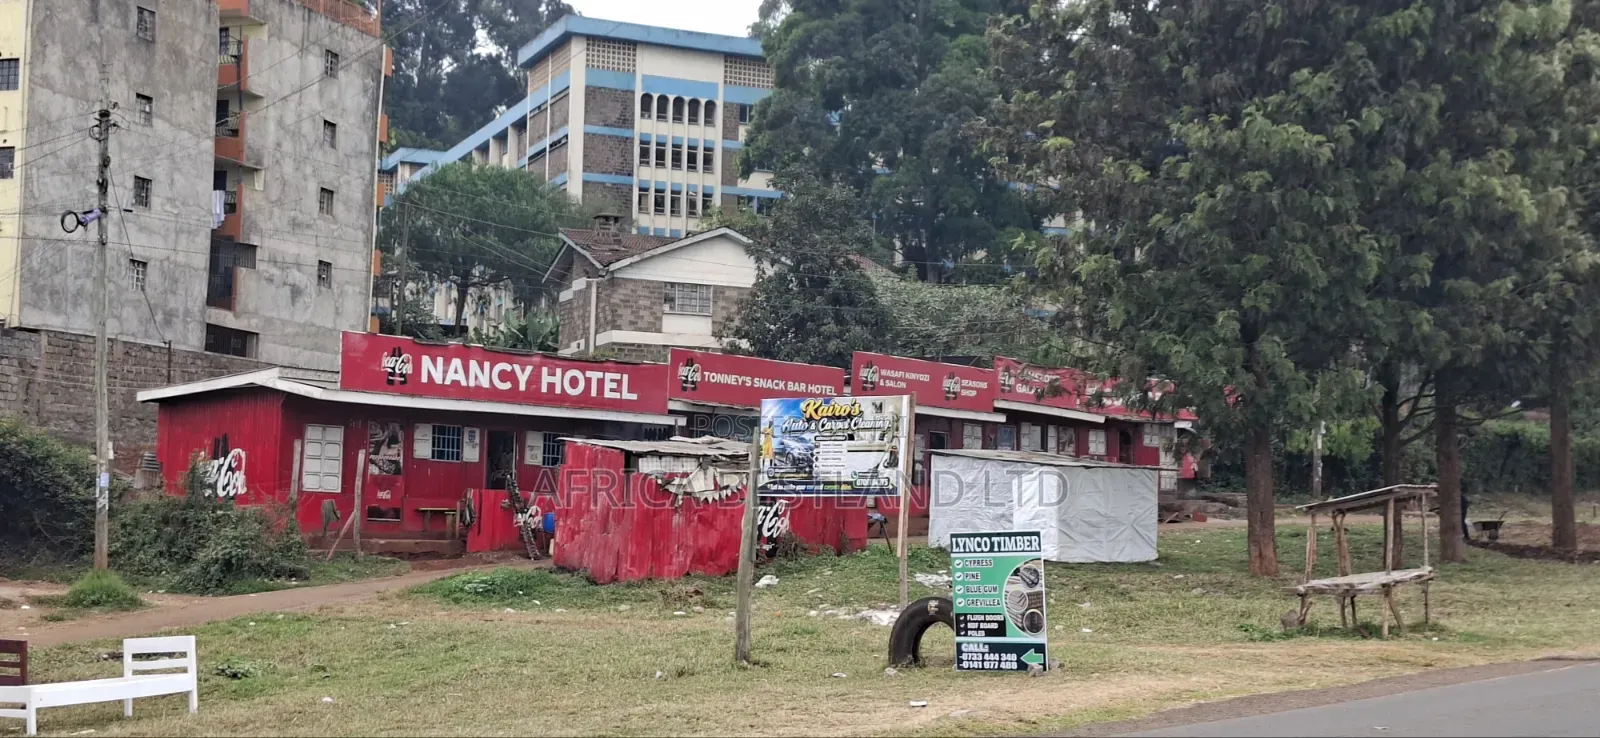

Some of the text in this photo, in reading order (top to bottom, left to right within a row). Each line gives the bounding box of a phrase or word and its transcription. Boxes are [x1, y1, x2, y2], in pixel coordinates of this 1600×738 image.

[421, 355, 637, 400] NANCY HOTEL
[880, 369, 930, 382] WASAFI KINYOZI
[704, 371, 837, 396] TONNEY'S SNACK BAR HOTEL
[886, 380, 907, 389] SALON
[961, 379, 988, 397] SEASONS SHOP
[802, 398, 863, 420] Kairo's
[781, 417, 808, 433] Auto
[819, 417, 850, 434] Carpet
[951, 535, 1040, 552] LYNCO TIMBER
[964, 559, 993, 567] CYPRESS
[964, 572, 980, 580] PINE
[983, 585, 998, 593] GUM
[966, 598, 1001, 606] GREVILLEA
[983, 653, 999, 661] 444
